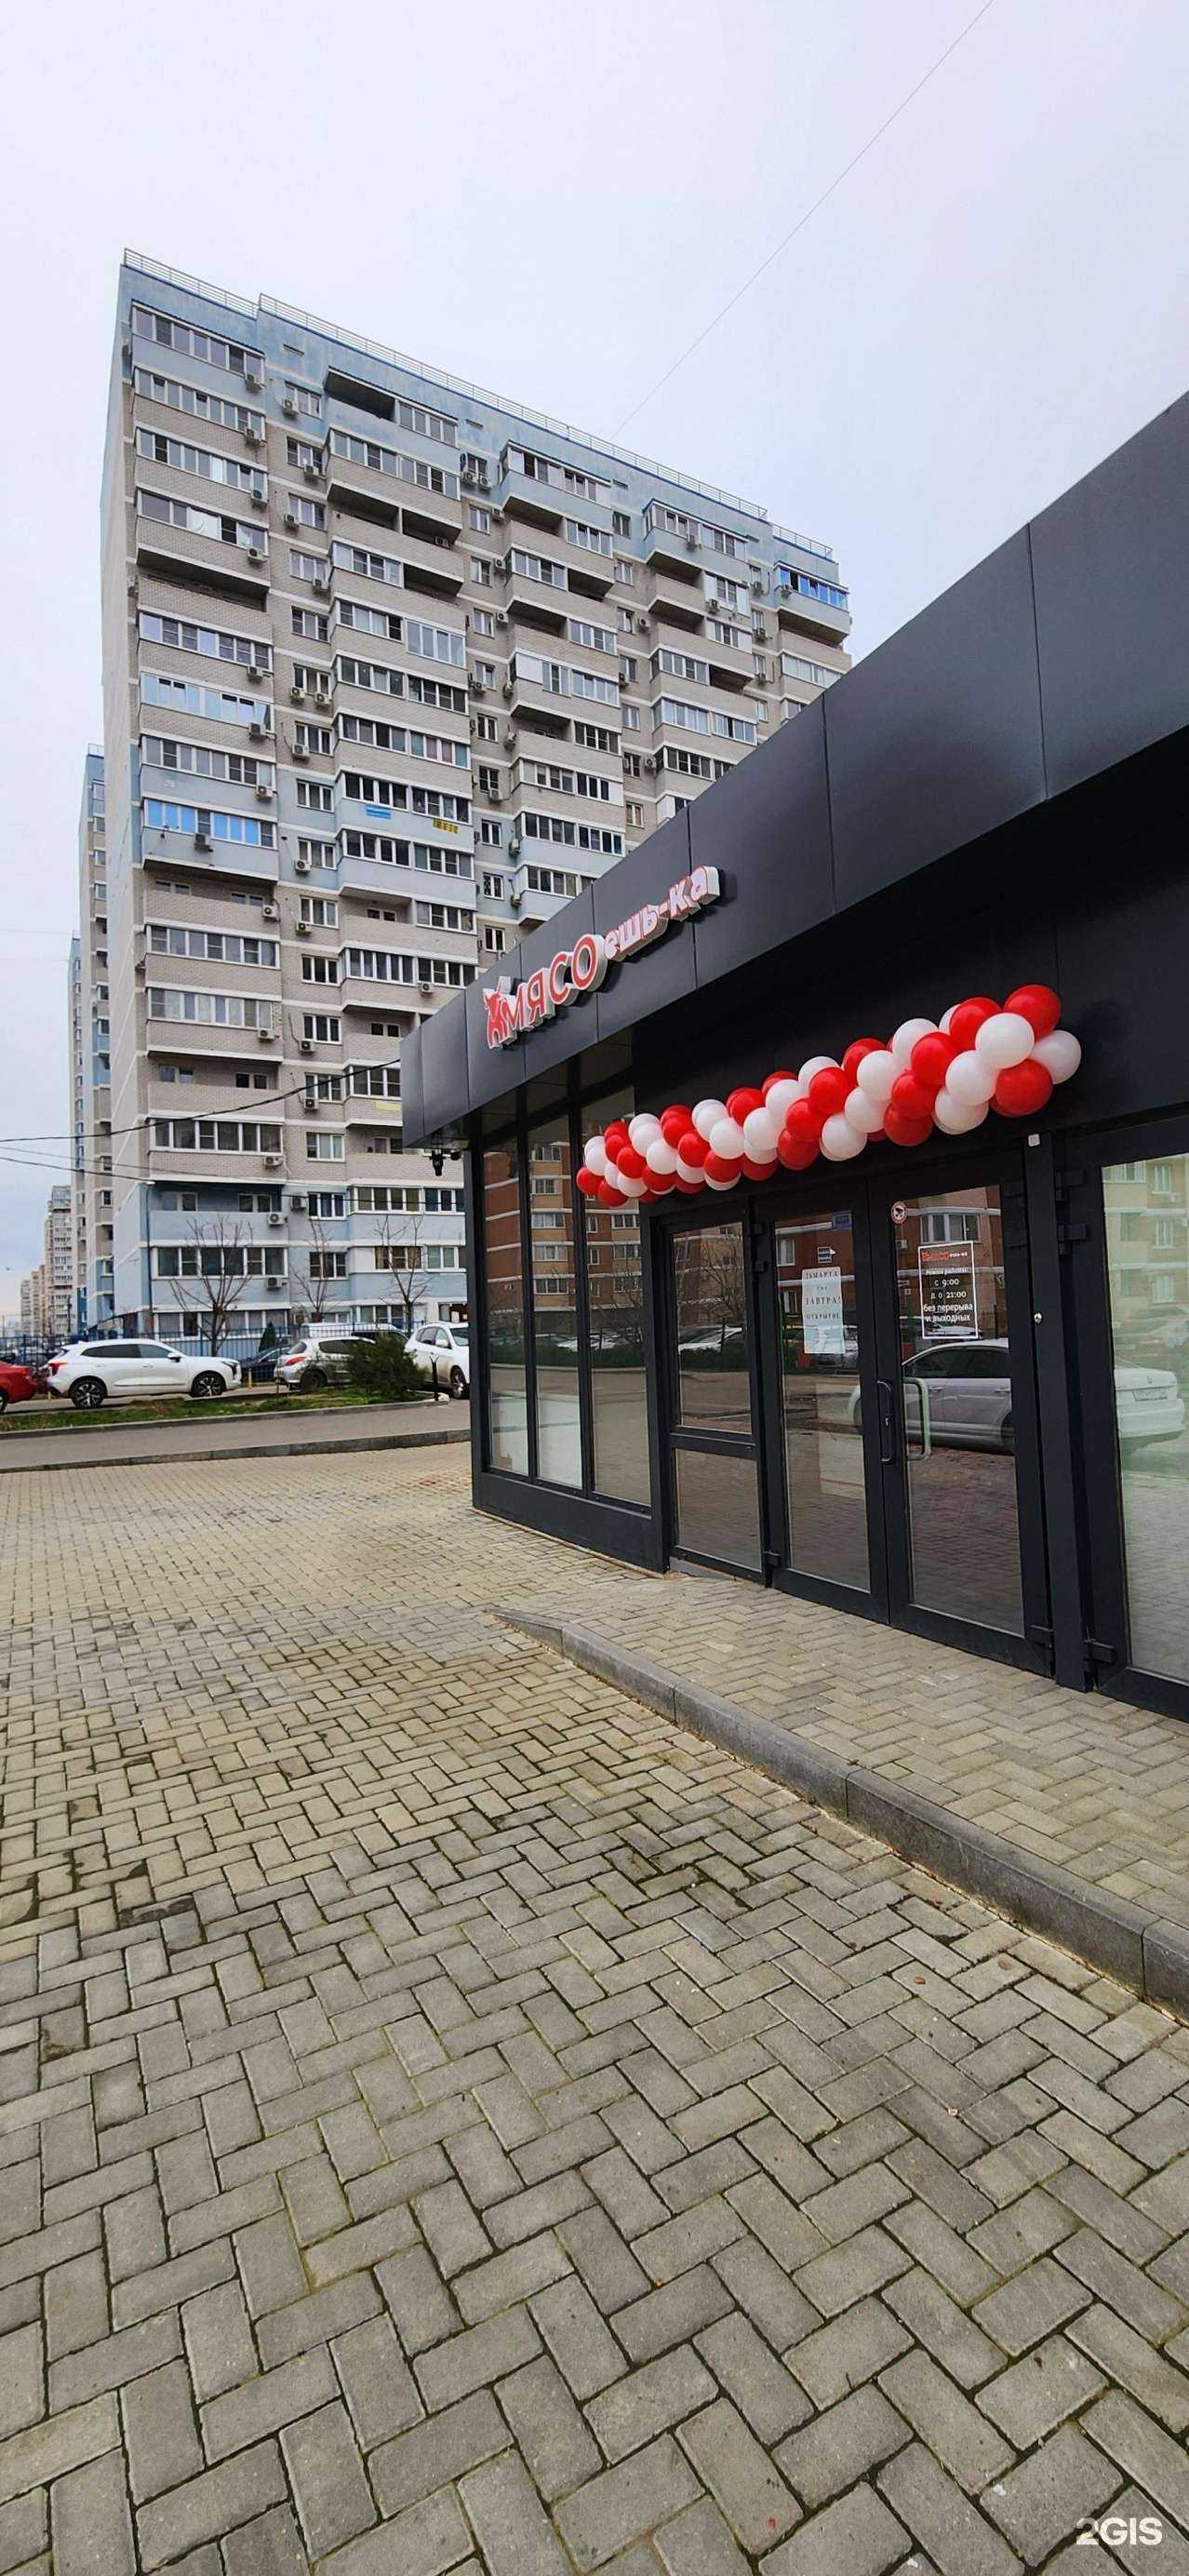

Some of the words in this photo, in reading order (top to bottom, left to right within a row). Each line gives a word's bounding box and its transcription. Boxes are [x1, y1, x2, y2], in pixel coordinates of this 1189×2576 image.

[500, 933, 607, 1042] МЯСО
[942, 1278, 959, 1288] 9:00
[945, 1291, 967, 1299] 21:00
[923, 1304, 936, 1312] без
[937, 1303, 973, 1313] перерыва
[932, 1314, 970, 1323] выходных
